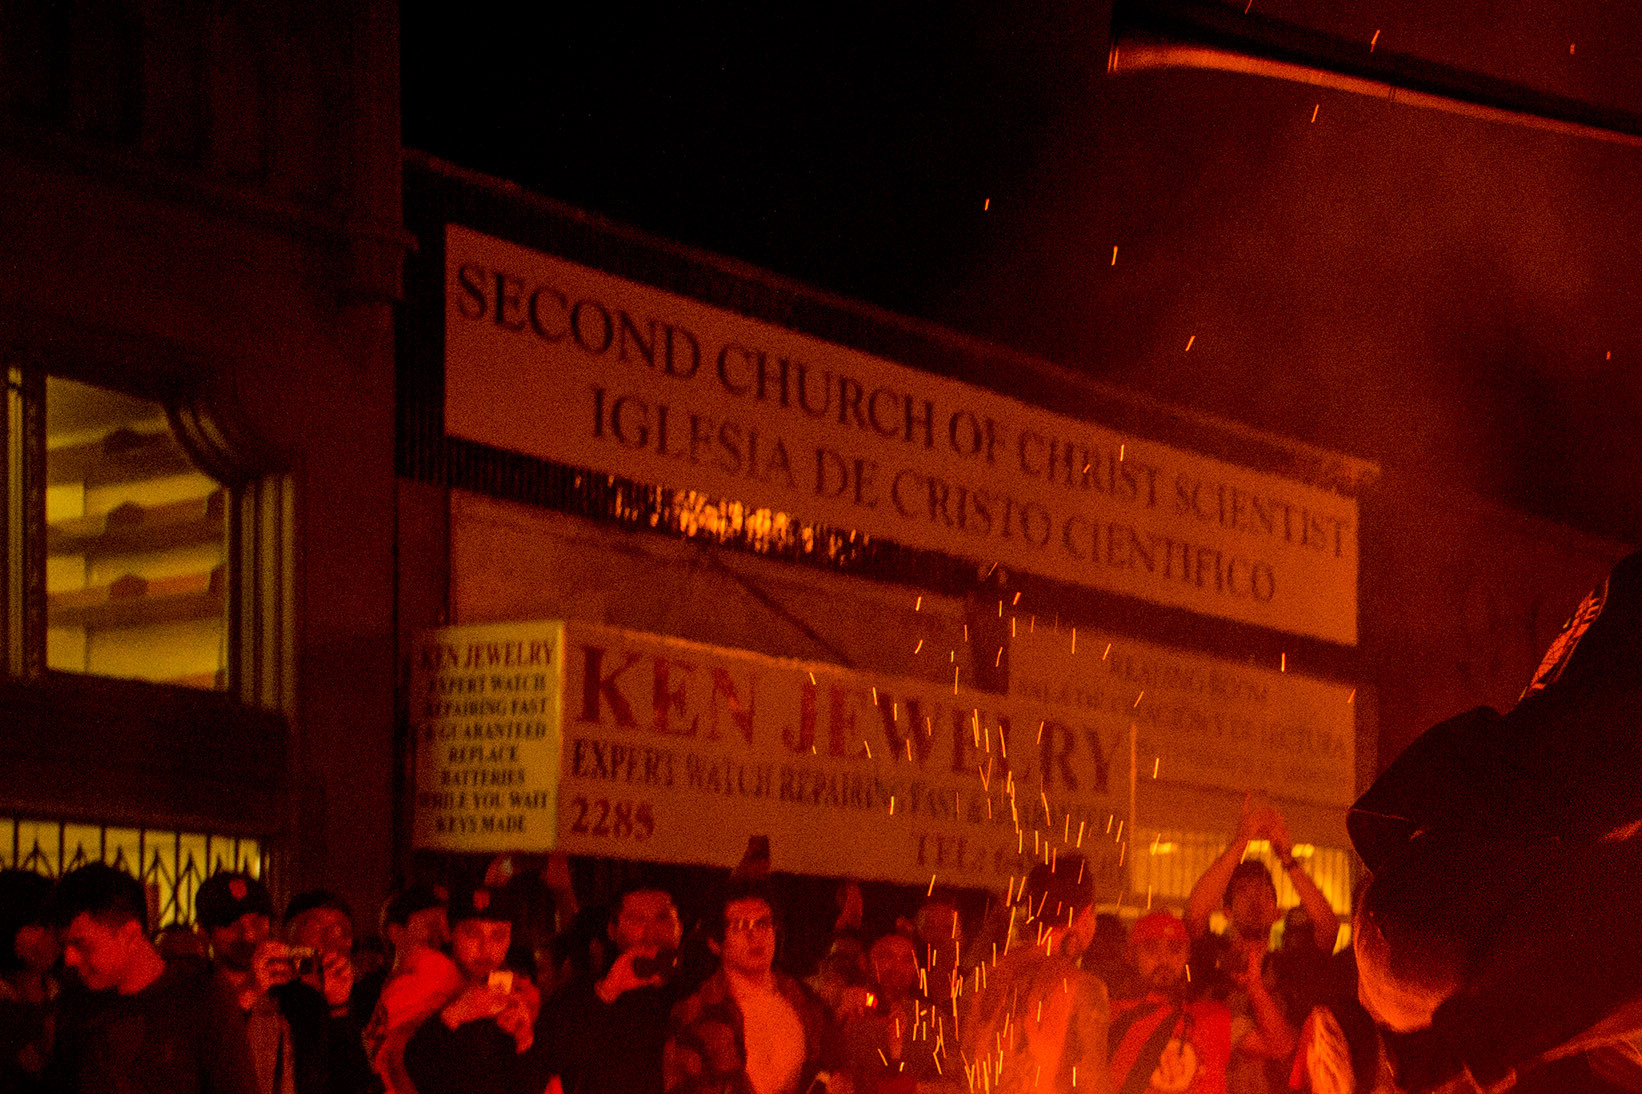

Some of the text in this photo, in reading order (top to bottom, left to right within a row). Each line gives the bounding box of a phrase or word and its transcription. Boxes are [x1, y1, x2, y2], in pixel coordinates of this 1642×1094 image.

[457, 264, 1352, 558] SECOND CHURCH OF CHRIST SCIENTIST
[591, 385, 1276, 602] IGLESIA DE CRISTO CIENTIFICO
[420, 641, 552, 669] KEN JEWELRY
[428, 674, 547, 694] EXPERT WATCH
[426, 698, 547, 717] REPAIRING FAST
[577, 645, 757, 746] KEN
[781, 680, 1122, 795] JEWELRY
[439, 722, 547, 740] GUARANTEED
[448, 744, 518, 763] REPLACE
[441, 768, 525, 786] BATTERIES
[571, 739, 678, 788] EXPERT
[684, 752, 775, 799] WATCH
[779, 762, 906, 814] REPAIRING
[418, 790, 548, 810] WHILE YOU WAIT
[435, 815, 526, 834] KEYS MADE
